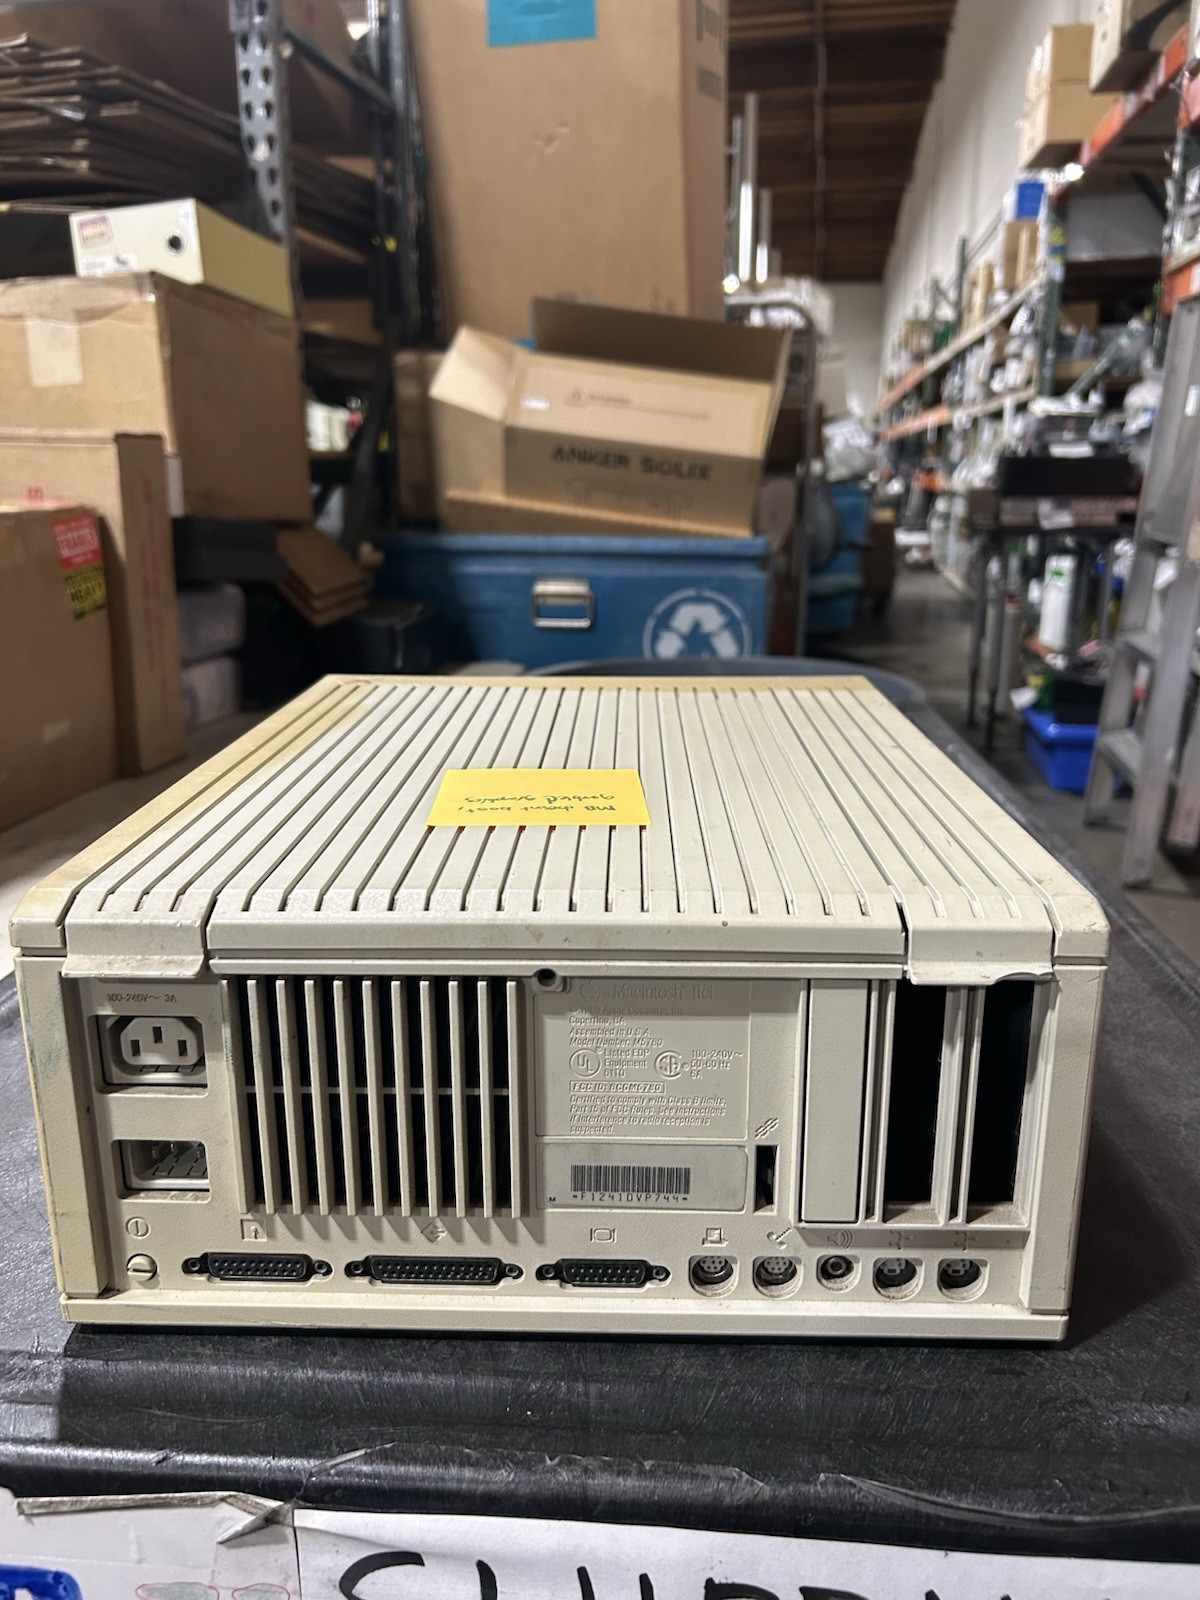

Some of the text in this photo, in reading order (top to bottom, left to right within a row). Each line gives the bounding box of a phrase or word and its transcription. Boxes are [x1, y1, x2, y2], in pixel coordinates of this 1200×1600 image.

[552, 447, 631, 470] ANKER
[164, 993, 178, 1003] 3A
[691, 984, 714, 1001] IIci
[603, 1006, 625, 1017] Apple
[568, 1027, 616, 1038] Assembled
[616, 1027, 625, 1037] in
[568, 1037, 596, 1048] Model
[595, 1037, 631, 1048] Number:
[603, 1049, 651, 1059] Listed EDP
[603, 1059, 648, 1070] Equipment
[718, 1060, 731, 1070] Hz
[690, 1070, 704, 1080] 6A
[571, 1082, 593, 1093] FCC
[593, 1082, 608, 1093] ID:
[569, 1094, 607, 1105] Certified
[607, 1095, 617, 1105] to
[617, 1096, 647, 1107] comply
[648, 1095, 667, 1106] with
[667, 1095, 693, 1106] Class
[692, 1096, 701, 1106] B
[569, 1105, 588, 1115] Part
[588, 1105, 600, 1115] 15
[600, 1105, 611, 1115] of
[610, 1105, 629, 1115] FCC
[657, 1106, 675, 1116] See
[675, 1106, 727, 1117] instructions
[569, 1115, 712, 1127] if interference to radio reception is
